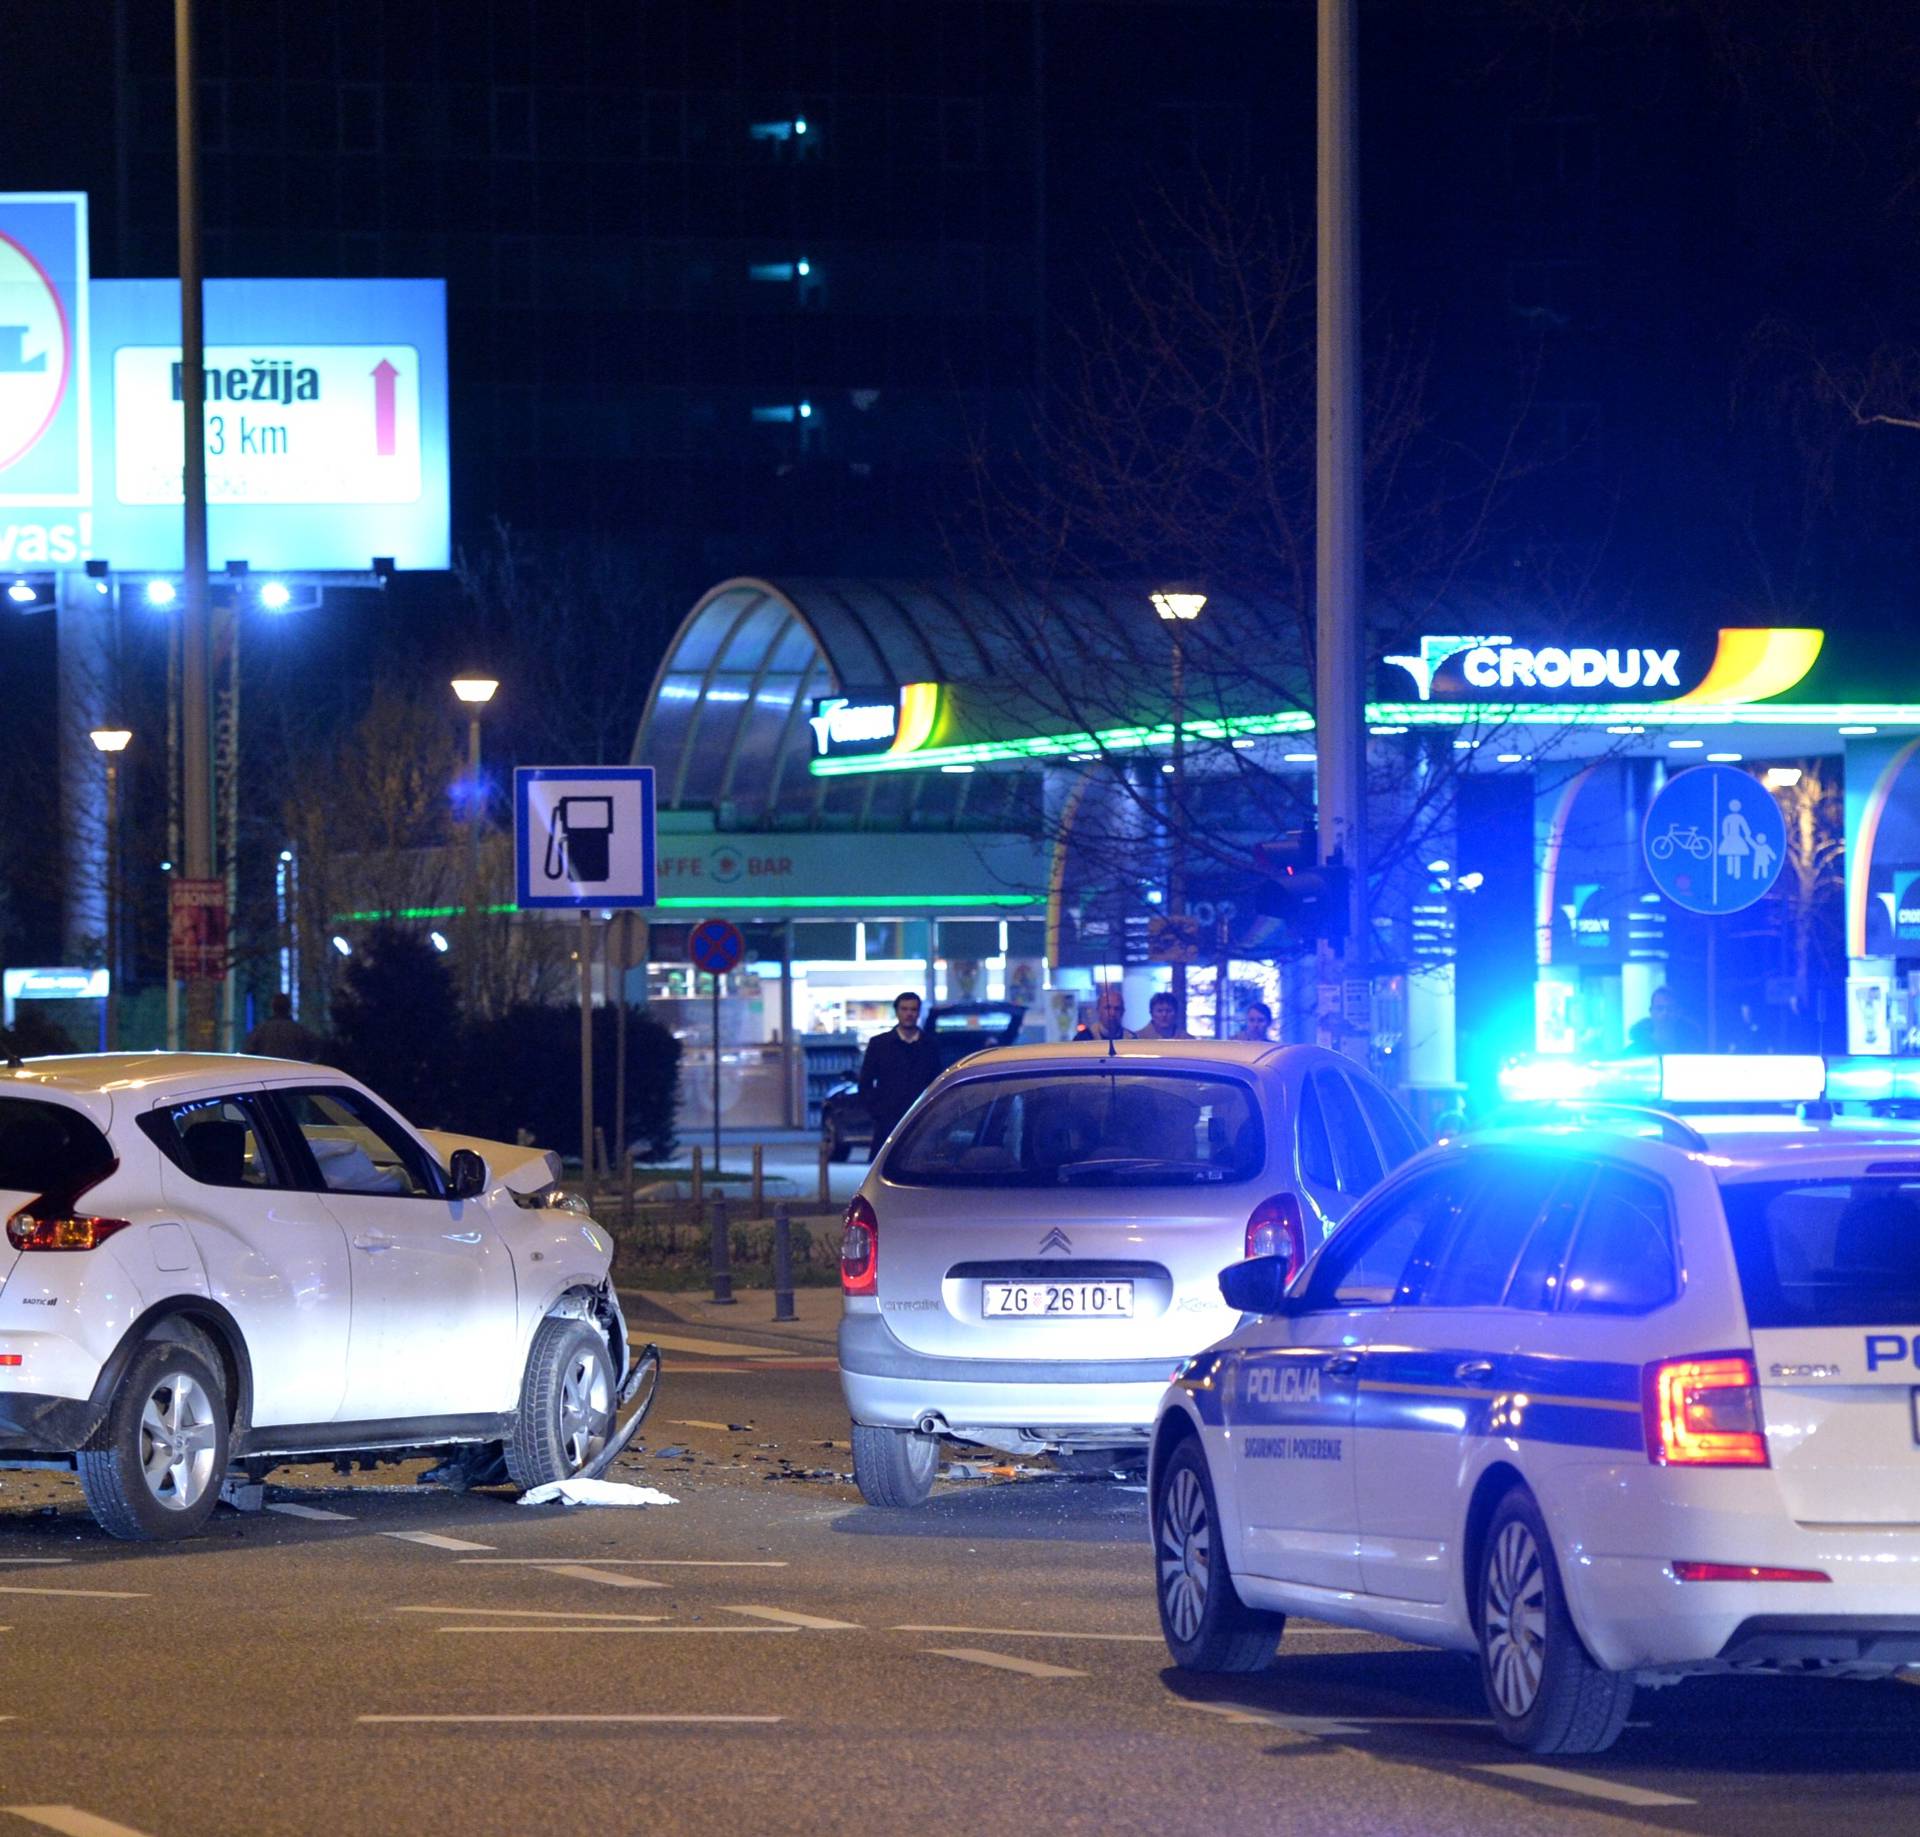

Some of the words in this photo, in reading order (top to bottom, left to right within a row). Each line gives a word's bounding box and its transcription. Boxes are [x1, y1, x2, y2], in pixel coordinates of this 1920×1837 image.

[209, 416, 225, 455] 3
[240, 416, 288, 454] km
[1463, 646, 1681, 688] CRODUX
[747, 857, 792, 876] BAR
[1000, 1288, 1028, 1311] ZG
[1046, 1287, 1126, 1311] 2610-L
[1865, 1335, 1920, 1371] P
[1247, 1367, 1320, 1403] POLICIJA
